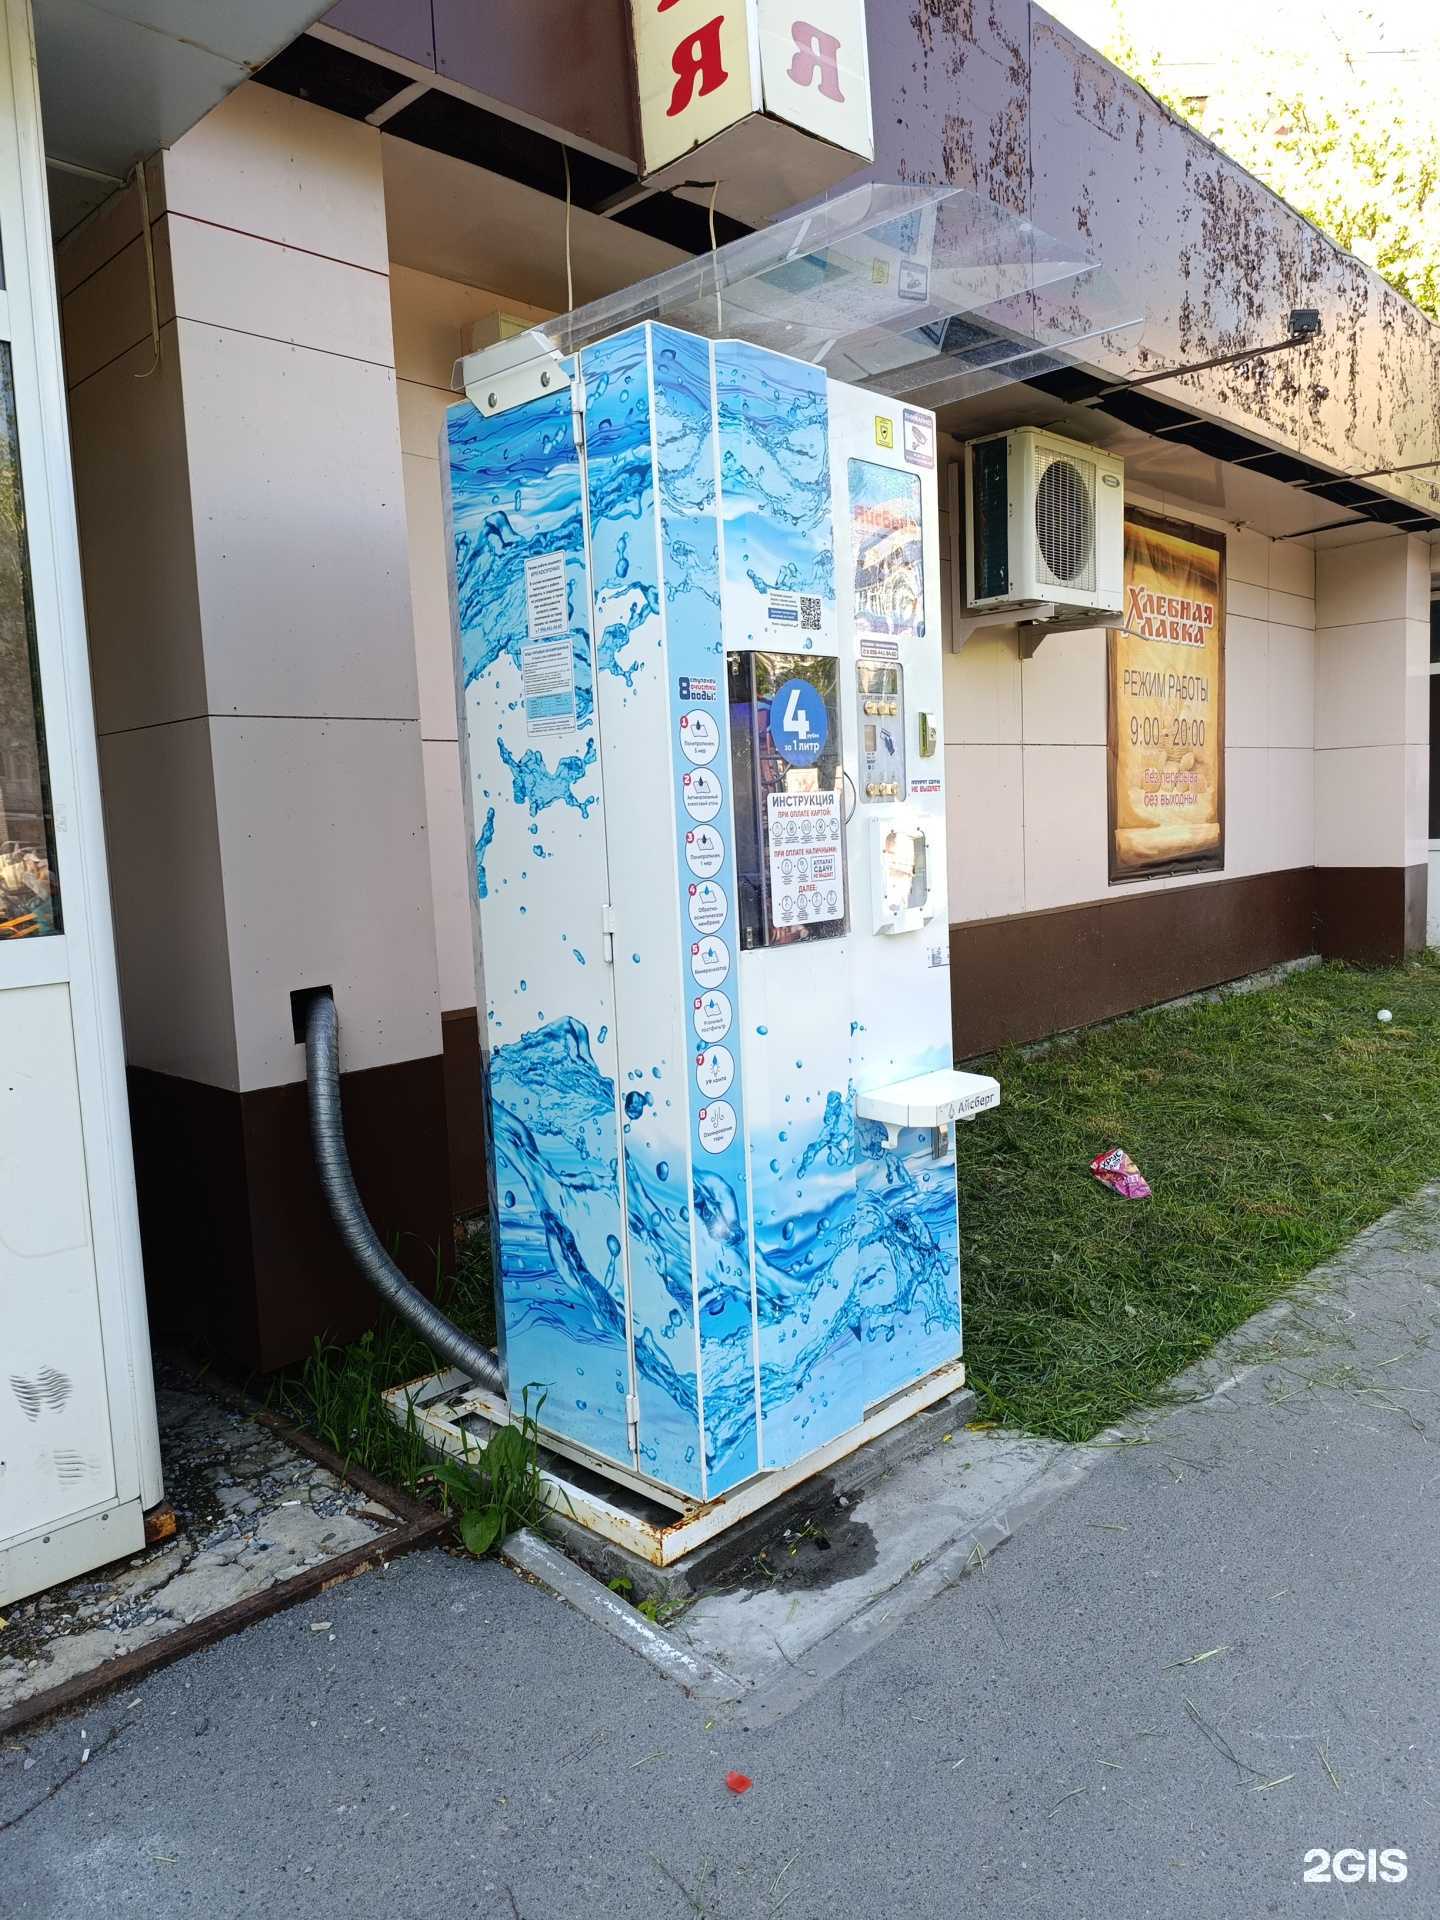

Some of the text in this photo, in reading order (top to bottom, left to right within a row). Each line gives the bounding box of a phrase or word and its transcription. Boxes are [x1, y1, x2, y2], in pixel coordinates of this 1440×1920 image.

[787, 20, 845, 103] Я
[679, 677, 690, 700] 8
[1123, 669, 1209, 702] РЕЖИМ РАБОТЫ
[783, 689, 810, 739] 4
[1130, 716, 1160, 745] 9:00
[1172, 718, 1205, 746] 20:00
[792, 739, 797, 751] 1
[798, 742, 820, 753] литр
[1144, 768, 1159, 784] без
[772, 794, 835, 808] ИНСТРУКЦИЯ
[1144, 791, 1198, 808] без выходных
